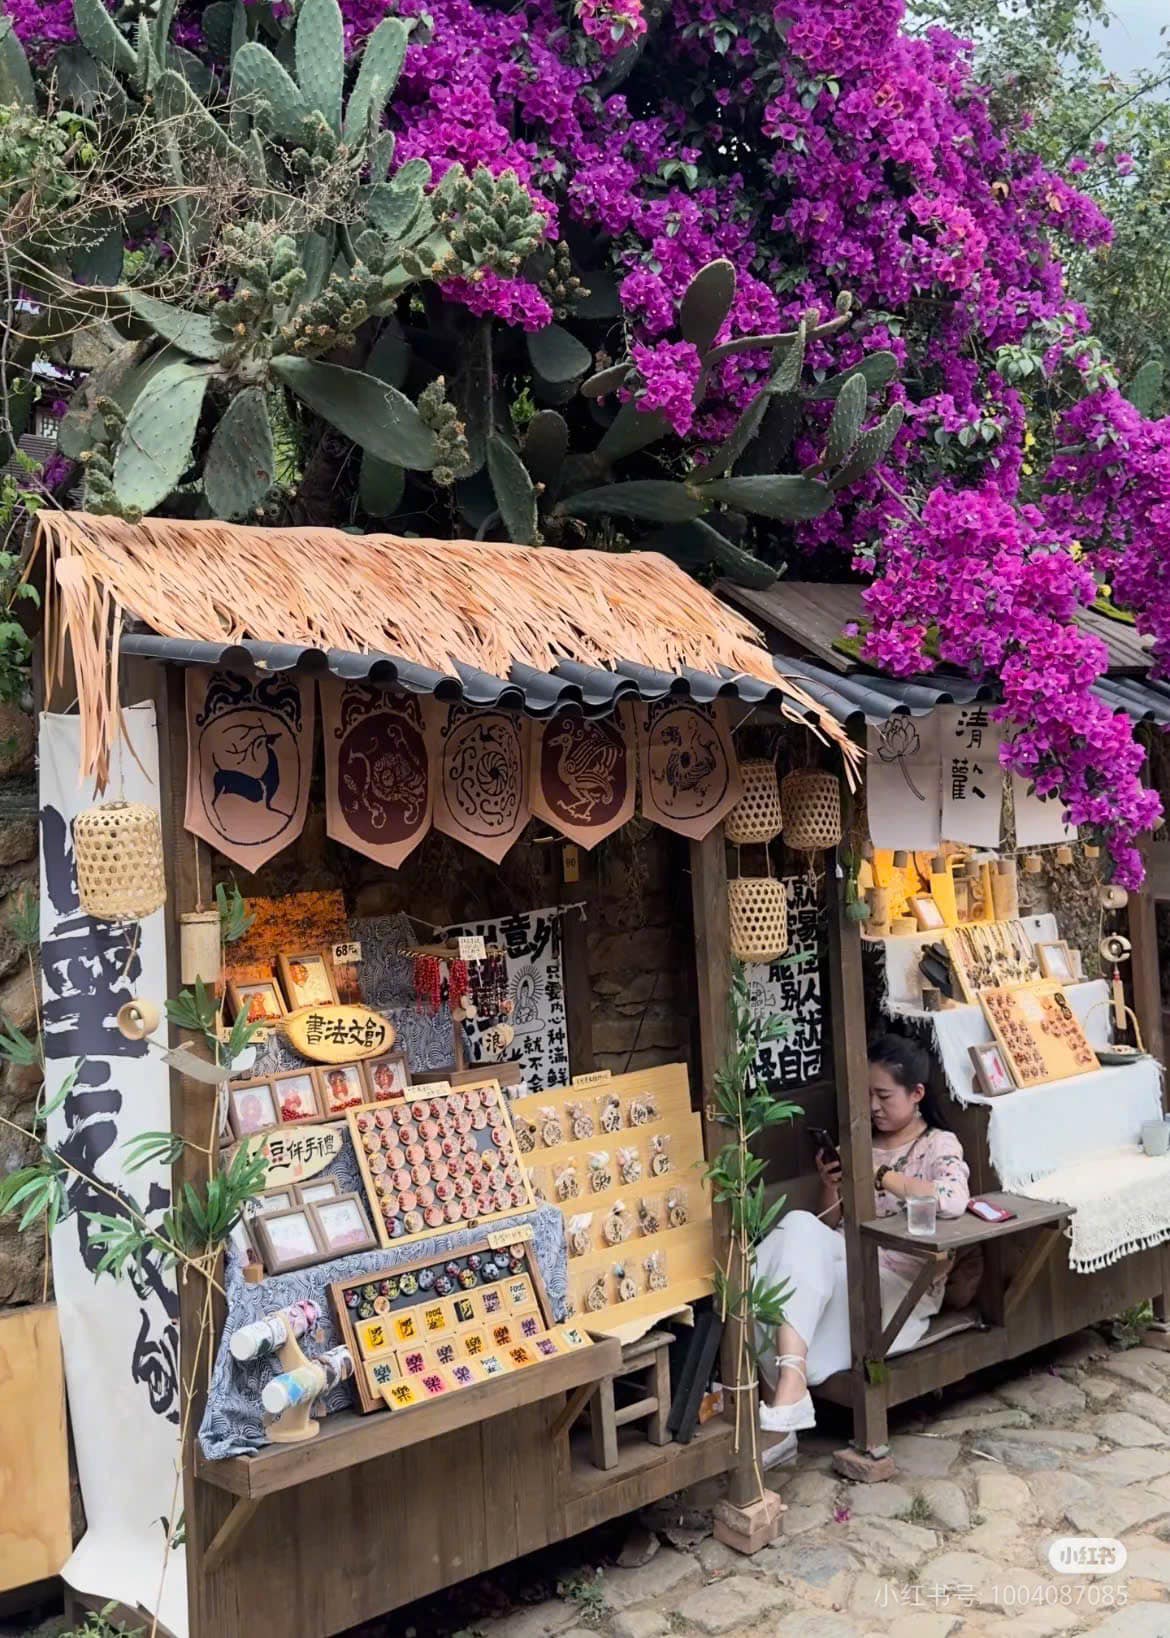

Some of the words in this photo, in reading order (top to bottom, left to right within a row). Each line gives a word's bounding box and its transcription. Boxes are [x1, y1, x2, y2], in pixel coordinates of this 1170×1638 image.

[305, 1012, 386, 1048] 書法文創
[523, 1035, 545, 1093] 就不会
[246, 1134, 338, 1173] 豆伴手禮
